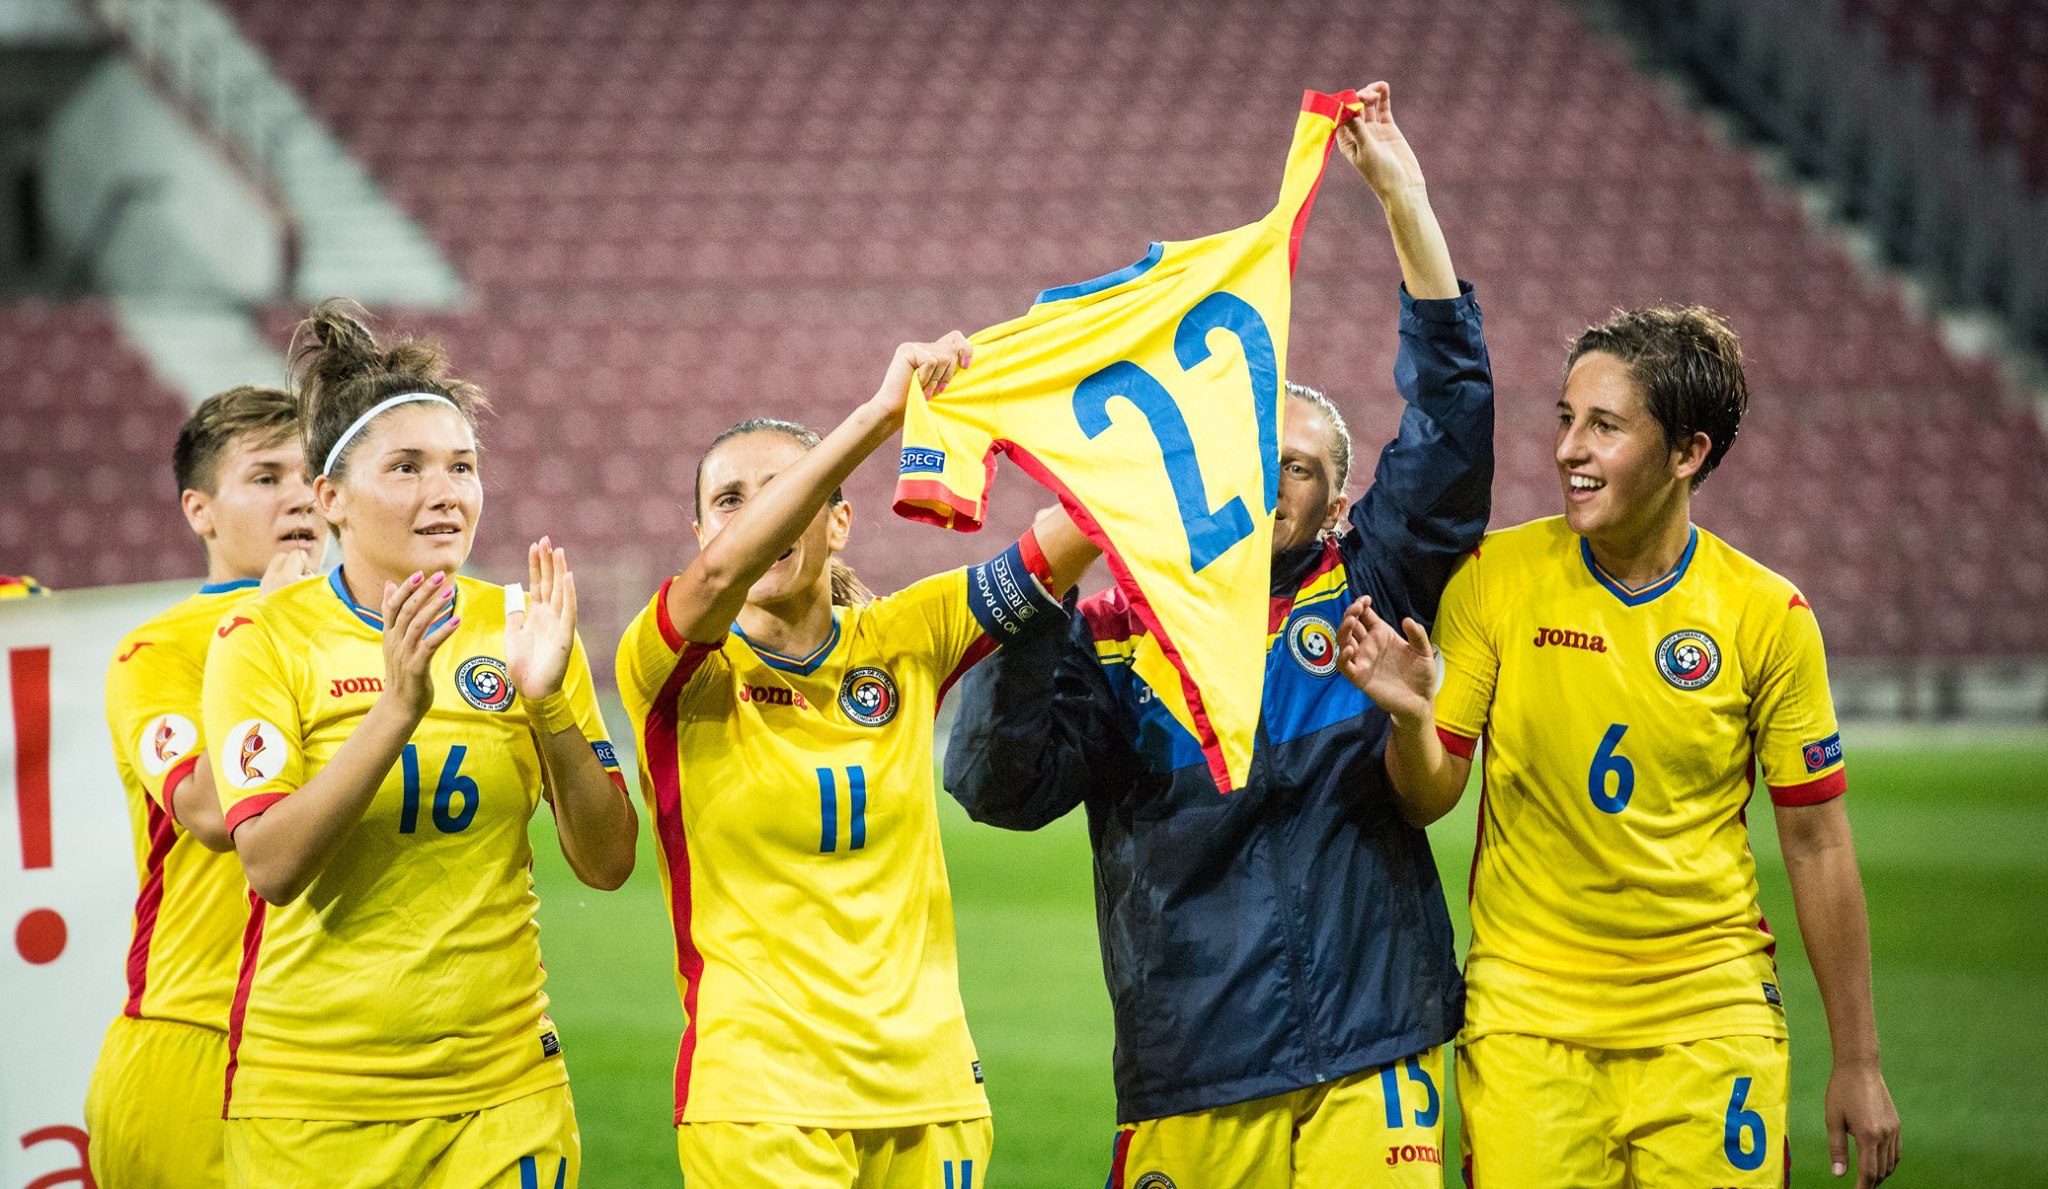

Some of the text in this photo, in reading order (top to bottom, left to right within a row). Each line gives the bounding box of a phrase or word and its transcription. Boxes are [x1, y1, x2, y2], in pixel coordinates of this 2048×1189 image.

[976, 564, 1020, 635] NO TO RACISM
[1533, 626, 1608, 653] Joma
[330, 676, 385, 698] Jom
[739, 682, 808, 711] Joma
[399, 744, 480, 834] 16
[596, 747, 615, 761] RE
[1588, 723, 1635, 815] 6
[815, 765, 867, 853] 11
[1380, 1055, 1440, 1129] 15
[1723, 1077, 1767, 1171] 6
